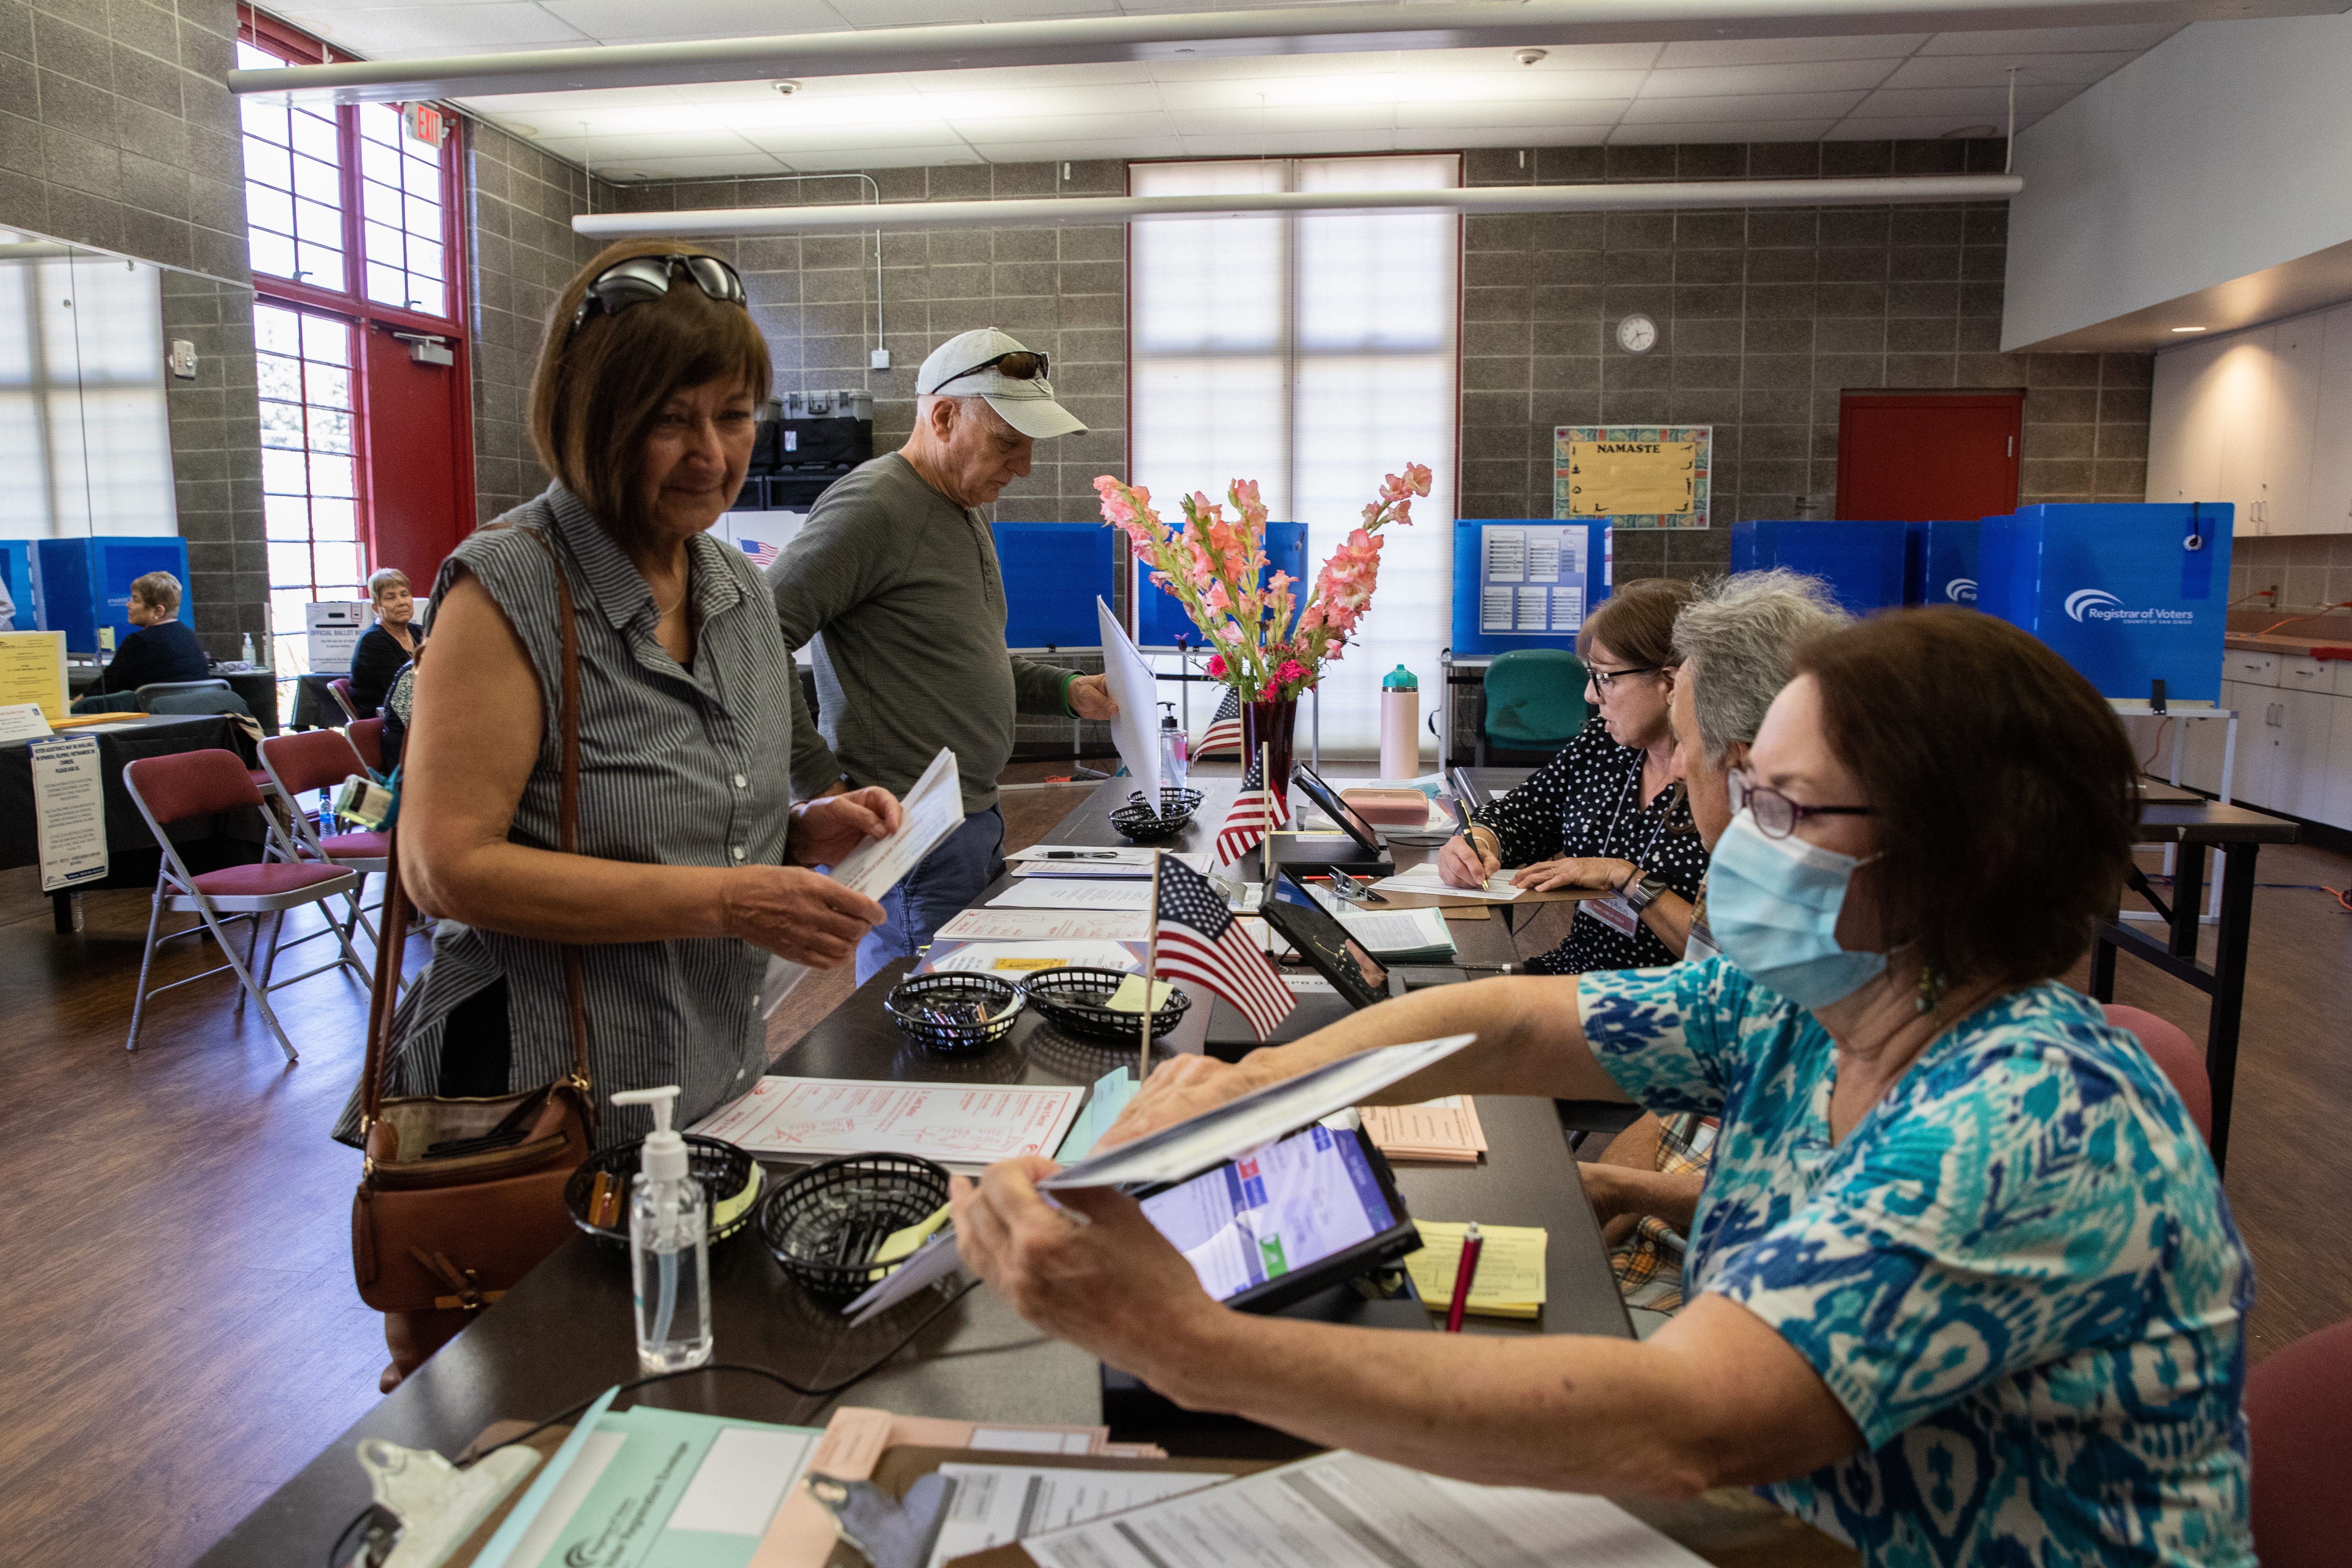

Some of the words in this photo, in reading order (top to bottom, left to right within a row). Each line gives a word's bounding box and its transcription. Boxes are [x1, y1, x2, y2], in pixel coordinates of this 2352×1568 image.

[418, 106, 439, 145] EXIT
[1597, 444, 1660, 453] NAMASTE
[2089, 608, 2140, 620] Registrar
[2141, 608, 2154, 618] of
[2155, 609, 2193, 619] Voters
